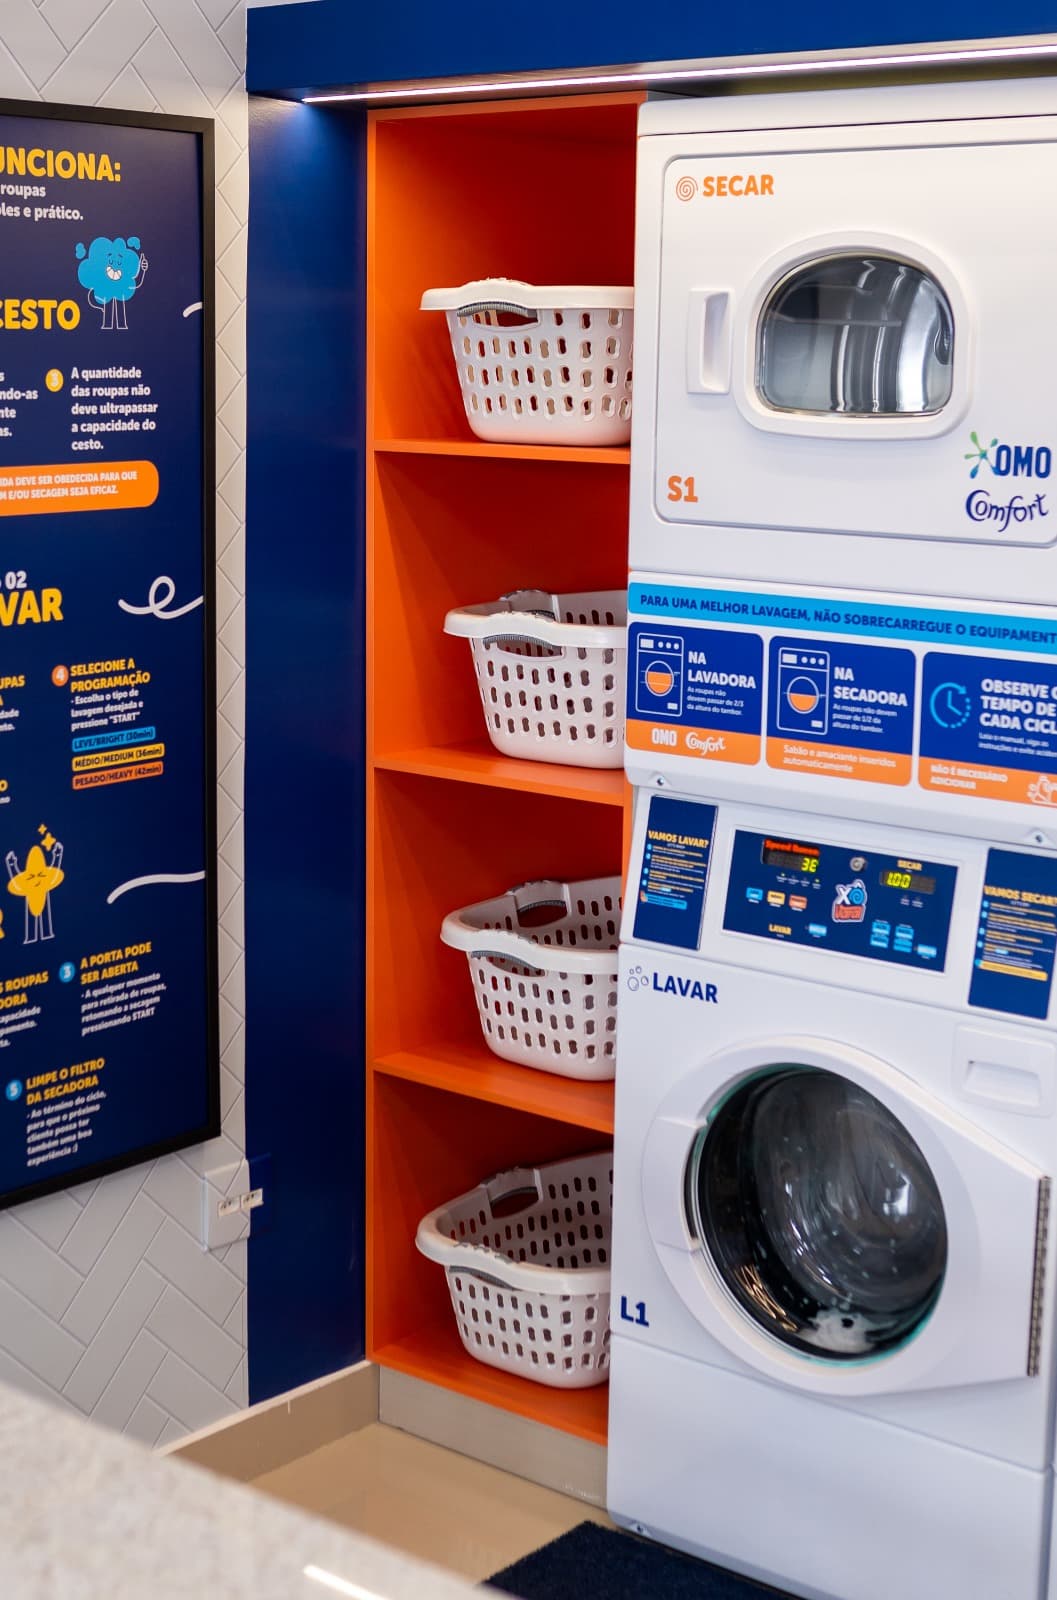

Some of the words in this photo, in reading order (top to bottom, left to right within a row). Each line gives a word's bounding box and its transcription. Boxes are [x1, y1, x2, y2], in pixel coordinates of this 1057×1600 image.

[0, 146, 121, 182] NCIONA:
[1, 183, 46, 199] roupas
[703, 174, 774, 197] SECAR
[0, 203, 20, 218] les
[23, 206, 31, 218] e
[34, 205, 84, 221] prático.
[0, 299, 80, 330] ESTO
[71, 367, 79, 379] A
[81, 366, 142, 382] quantidade
[71, 384, 90, 397] das
[92, 386, 129, 399] roupas
[131, 384, 151, 396] não
[71, 402, 98, 415] deve
[100, 402, 158, 416] ultrapassar
[71, 423, 78, 433] a
[80, 419, 140, 435] capacidade
[142, 419, 156, 430] do
[71, 439, 104, 450] cesto.
[995, 444, 1051, 479] OMO
[667, 475, 698, 503] S1
[966, 489, 1049, 533] Comfort
[5, 570, 28, 590] 02
[640, 594, 669, 607] PARA
[672, 597, 698, 610] UMA
[699, 598, 749, 615] MELHOR
[751, 603, 811, 622] LAVAGEM,
[814, 608, 841, 624] NÃO
[844, 613, 953, 634] SOBRECARREGUE
[955, 623, 966, 635] O
[70, 659, 126, 677] SELECIONE
[127, 657, 136, 670] A
[688, 651, 707, 665] NA
[55, 668, 65, 681] 4
[70, 671, 151, 693] PROGRAMAÇÃO
[687, 669, 756, 689] LAVADORA
[834, 667, 854, 681] NA
[74, 693, 105, 705] Escolha
[112, 690, 128, 702] tipo
[129, 688, 139, 698] de
[833, 685, 908, 707] SECADORA
[980, 678, 1050, 699] OBSERVE
[980, 695, 1033, 714] TEMPO
[1035, 702, 1057, 717] DE
[979, 712, 1021, 730] CADA
[651, 727, 678, 746] OMO
[685, 731, 726, 755] Comfort
[648, 830, 677, 843] VAMOS
[678, 835, 709, 848] LAVAR?
[80, 957, 89, 970] A
[90, 949, 124, 968] PORTA
[125, 941, 152, 959] PODE
[5, 970, 49, 991] ROUPAS
[81, 971, 100, 986] SER
[101, 961, 139, 980] ABERTA
[653, 972, 718, 1004] LAVAR
[26, 1071, 57, 1090] LIMPE
[59, 1069, 69, 1080] O
[70, 1057, 105, 1077] FILTRO
[26, 1093, 41, 1106] DA
[43, 1075, 99, 1100] SECADORA
[621, 1296, 650, 1328] L1
